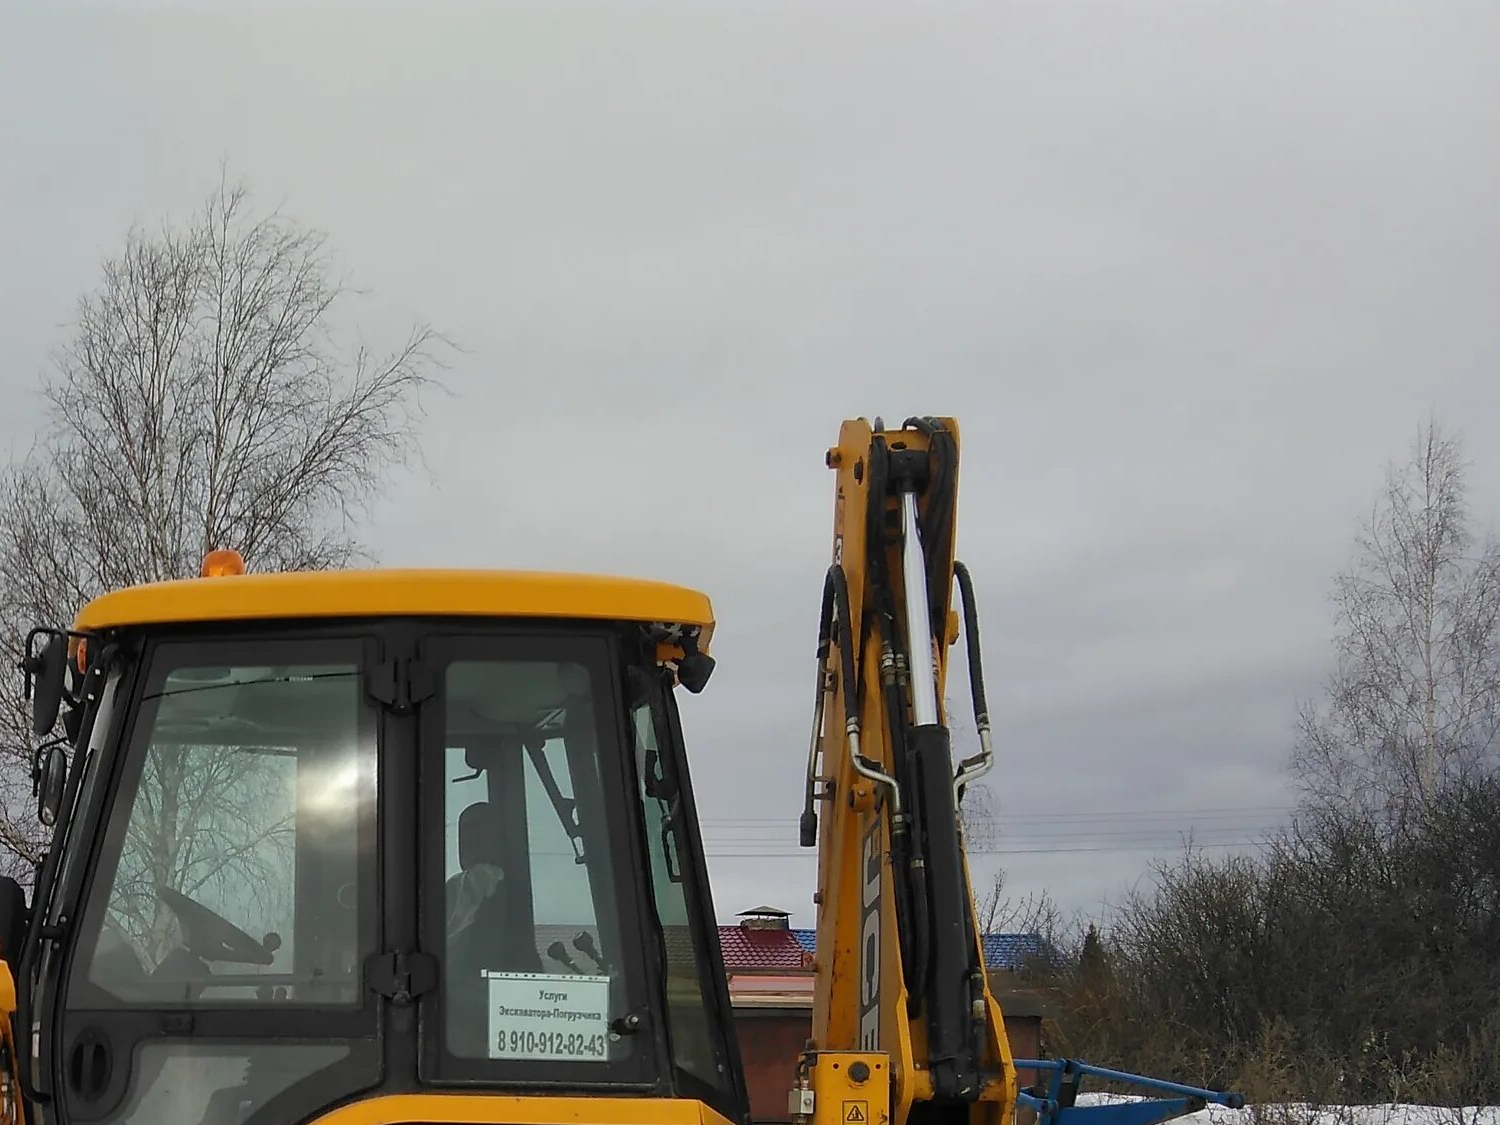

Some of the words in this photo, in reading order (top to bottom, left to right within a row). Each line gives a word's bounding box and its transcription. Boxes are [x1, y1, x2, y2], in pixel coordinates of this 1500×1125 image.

[538, 990, 568, 1003] Услуги
[498, 1030, 506, 1051] 8
[510, 1031, 605, 1056] 910-912-82-43
